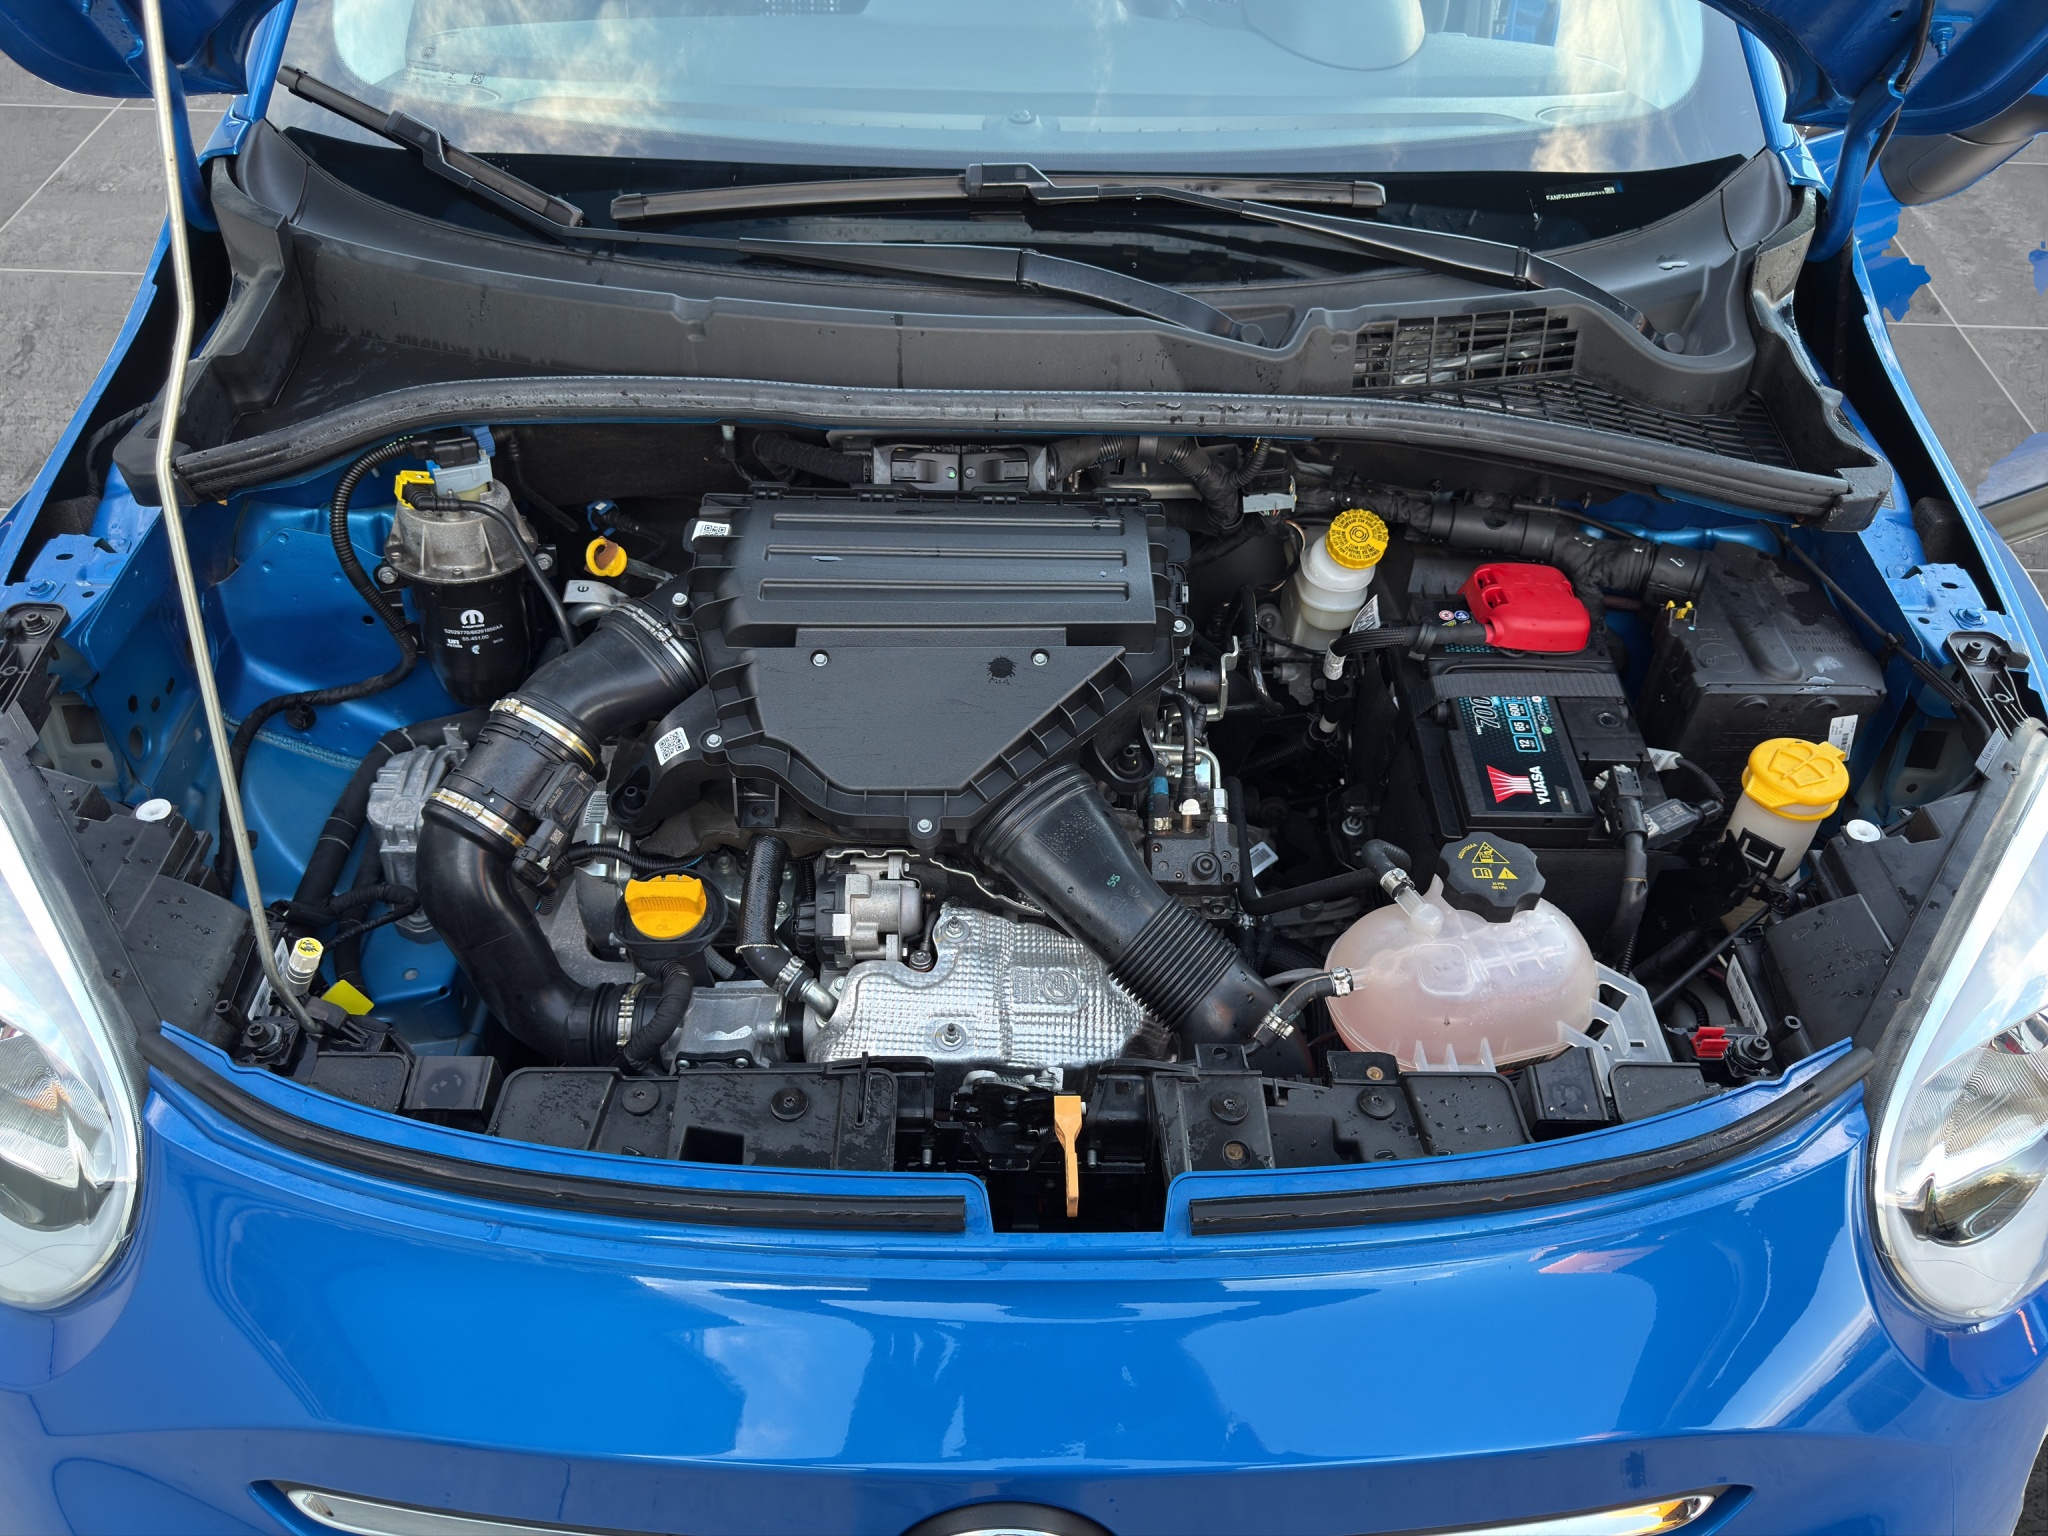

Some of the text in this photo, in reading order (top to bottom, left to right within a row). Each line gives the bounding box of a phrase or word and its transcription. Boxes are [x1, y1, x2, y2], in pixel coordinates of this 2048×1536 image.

[1508, 703, 1521, 717] 600
[1513, 721, 1526, 732] 65
[1519, 739, 1531, 749] 12
[1529, 765, 1551, 805] YUASA
[656, 924, 672, 932] OIL
